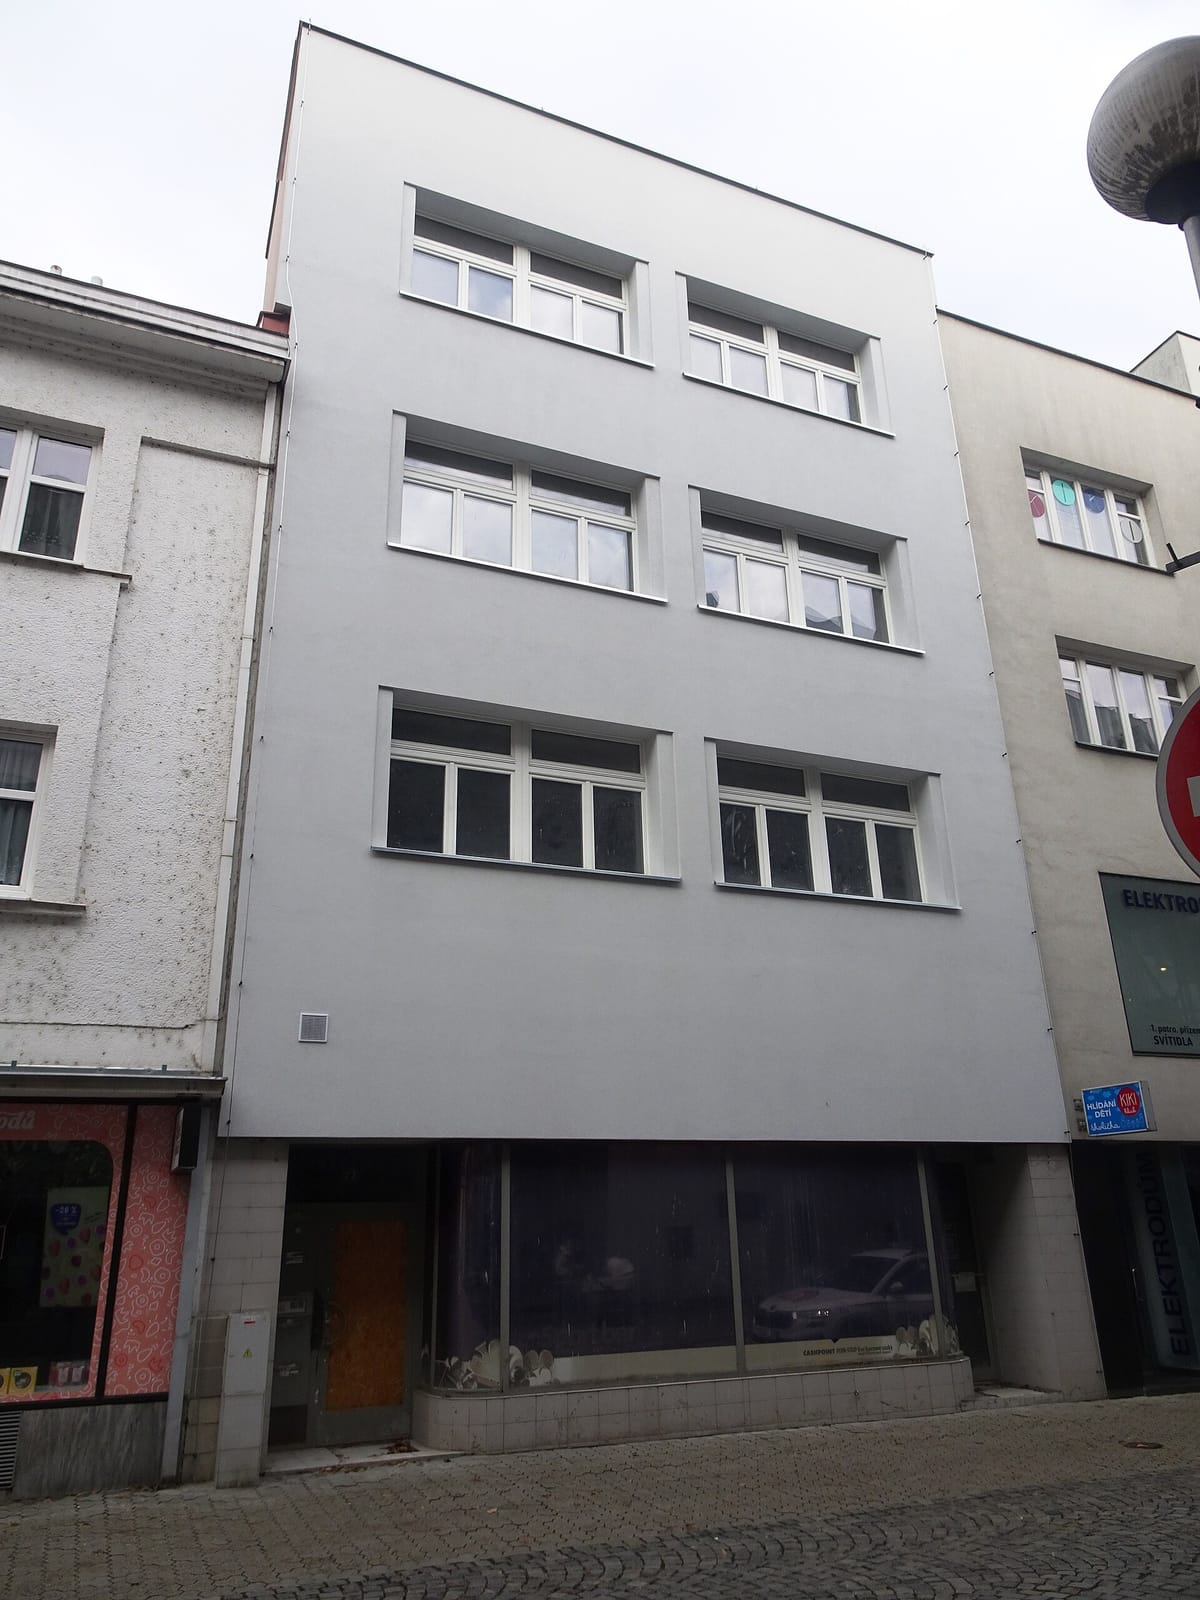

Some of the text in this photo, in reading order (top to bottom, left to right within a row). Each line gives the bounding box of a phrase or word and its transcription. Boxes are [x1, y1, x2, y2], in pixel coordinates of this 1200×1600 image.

[1121, 889, 1200, 914] ELEKTRO
[1153, 1033, 1193, 1047] SVÍTIDLA
[1086, 1098, 1117, 1110] HLÍDÁNÍ
[1119, 1091, 1138, 1107] KIKI
[1094, 1108, 1112, 1118] DĚTÍ
